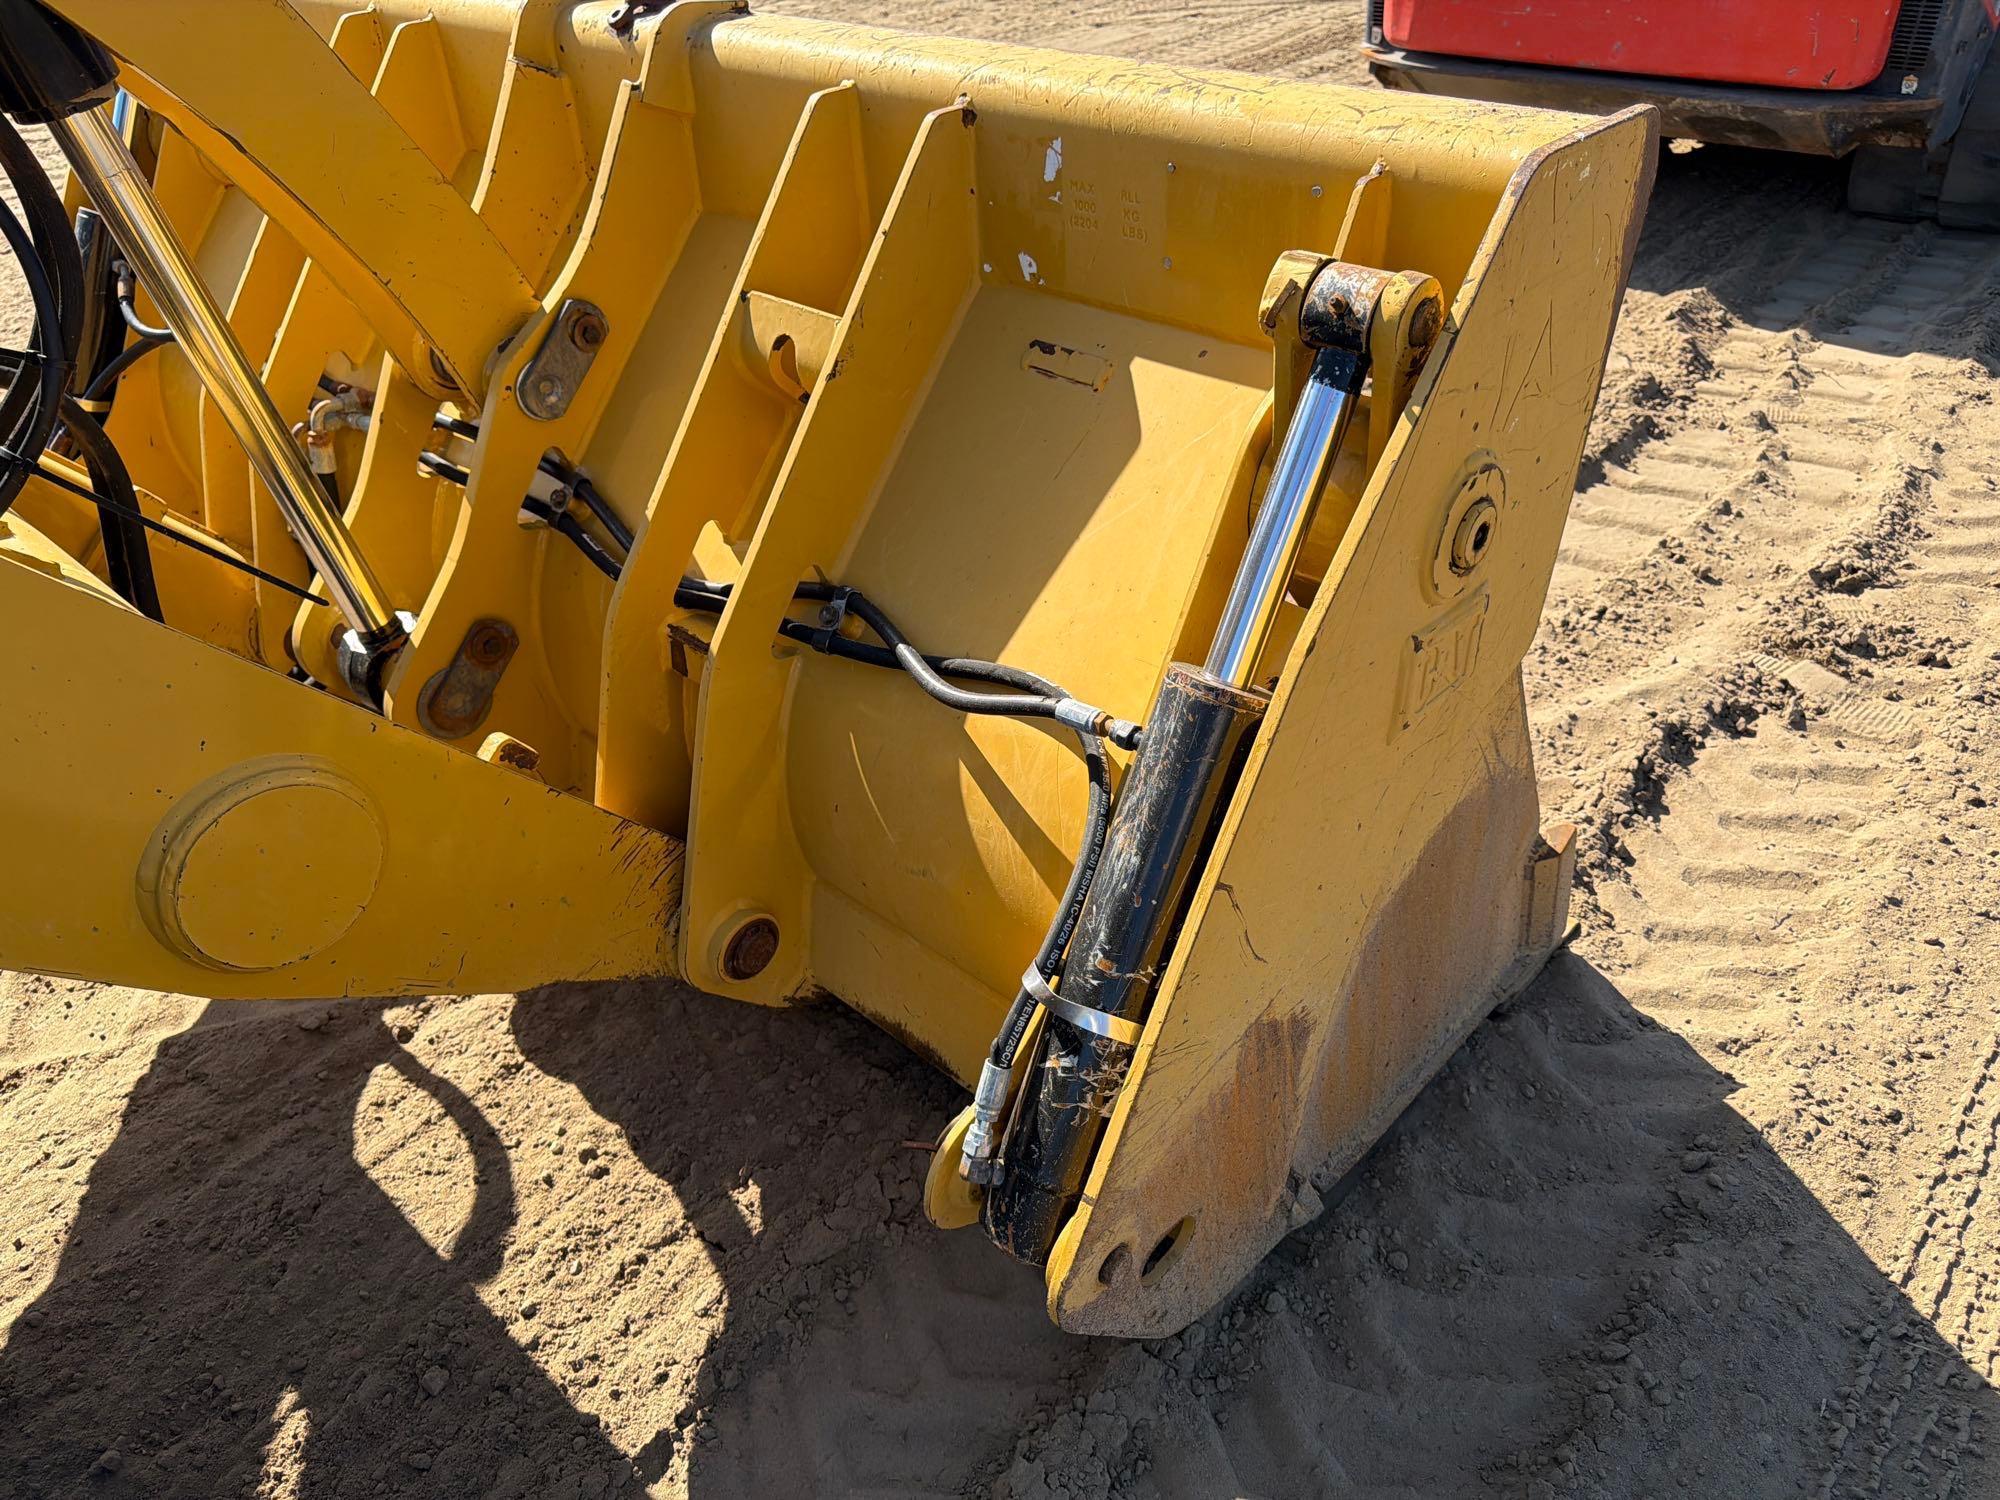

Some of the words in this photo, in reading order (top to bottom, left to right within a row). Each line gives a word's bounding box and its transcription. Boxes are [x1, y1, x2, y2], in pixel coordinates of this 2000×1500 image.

[1070, 179, 1095, 195] MAX
[1123, 207, 1140, 223] KG
[1094, 815, 1107, 844] (5000
[1086, 845, 1101, 868] PSI)
[1076, 868, 1094, 901] MSHA
[1057, 902, 1081, 946] IC-40/26
